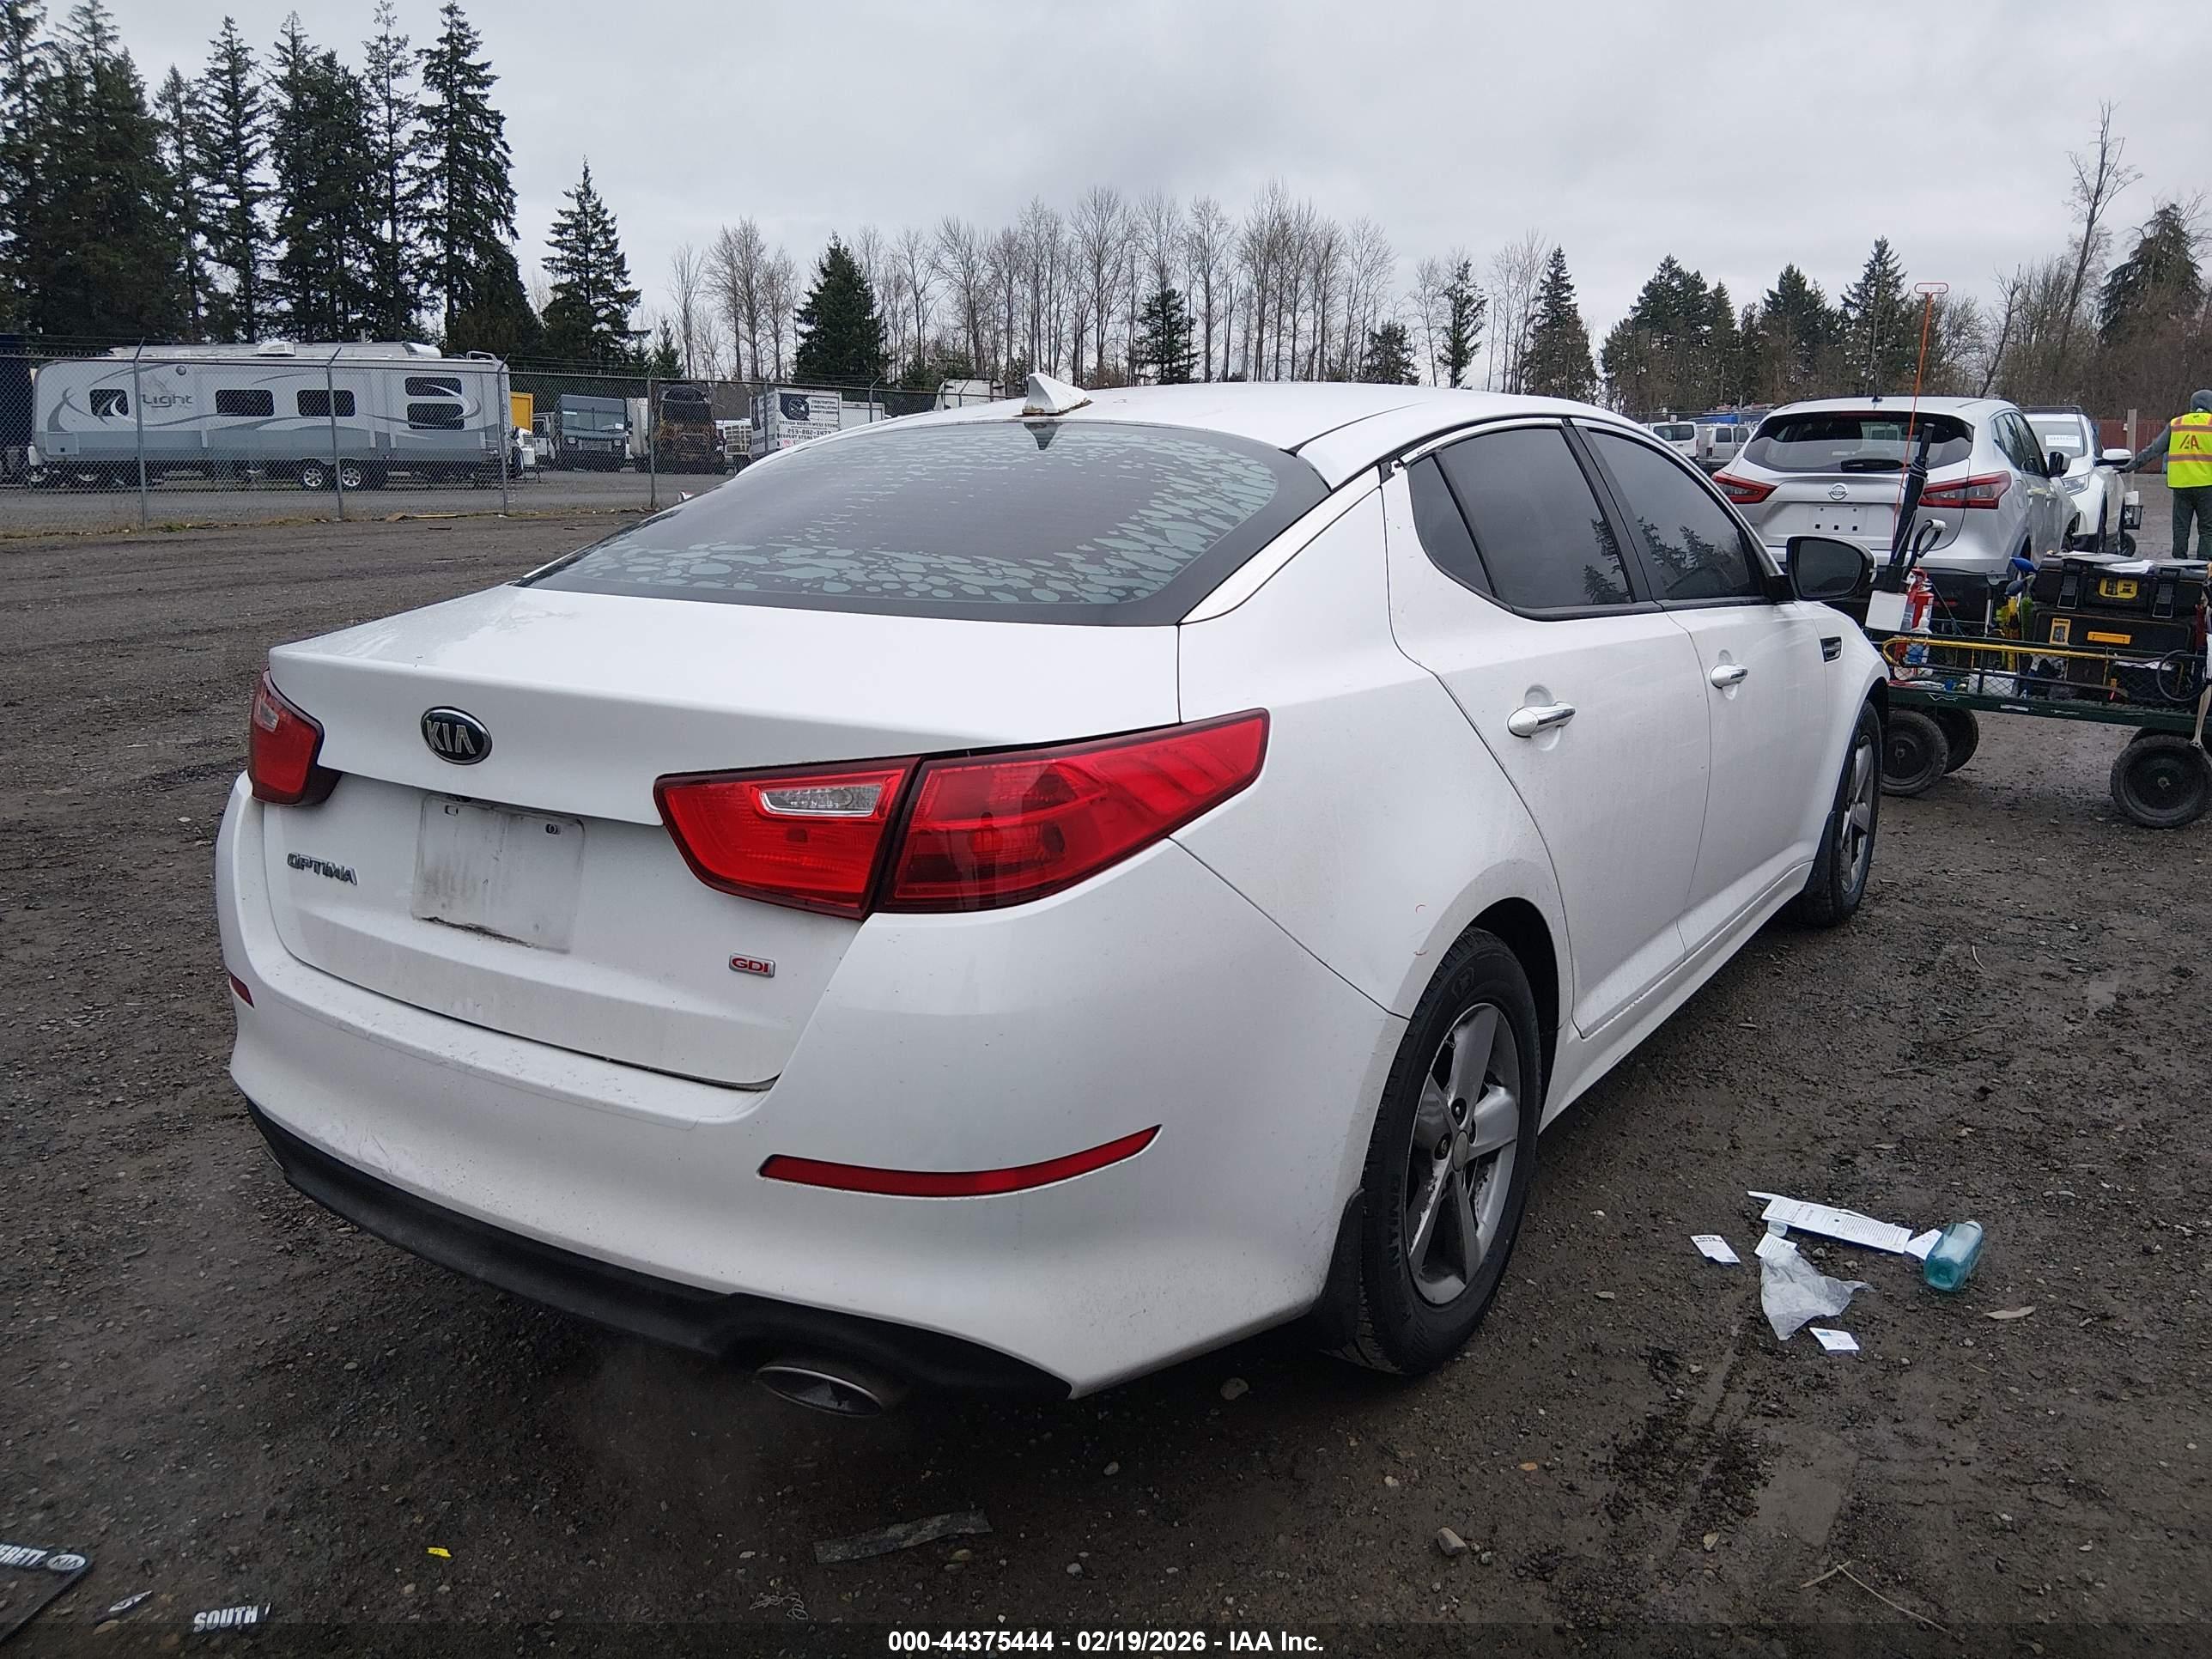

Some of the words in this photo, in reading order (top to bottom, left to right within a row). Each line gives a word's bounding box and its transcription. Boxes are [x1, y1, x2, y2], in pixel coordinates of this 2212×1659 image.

[426, 720, 477, 755] KIA
[287, 852, 358, 885] OPTIMA
[732, 957, 769, 973] GDI
[192, 1605, 258, 1633] SOUTH
